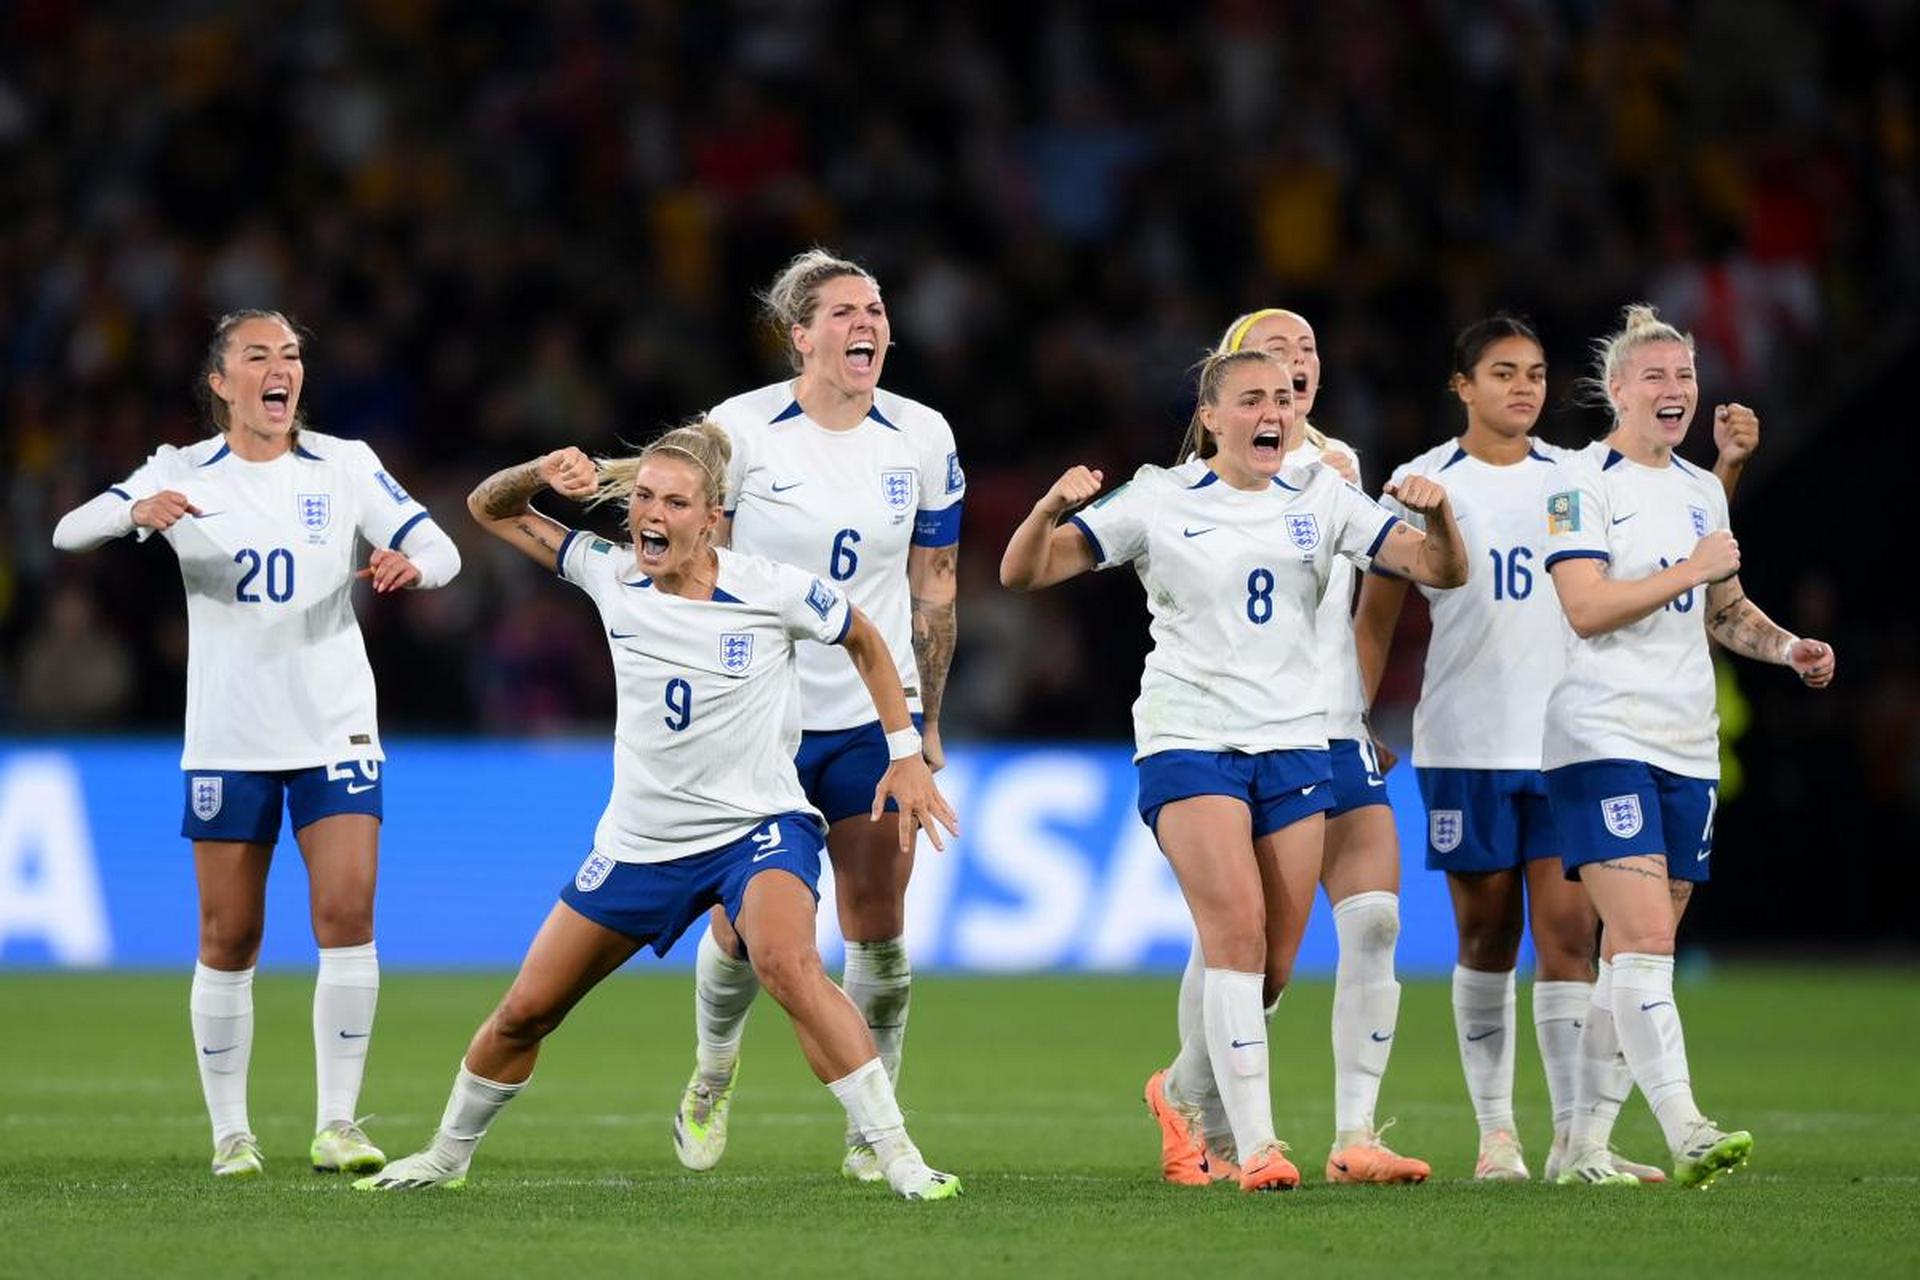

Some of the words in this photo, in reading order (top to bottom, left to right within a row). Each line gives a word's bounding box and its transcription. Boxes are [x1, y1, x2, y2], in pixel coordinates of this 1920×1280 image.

[234, 548, 294, 603] 20
[830, 528, 861, 581] 6
[1489, 547, 1532, 601] 16
[1247, 568, 1274, 624] 8
[664, 678, 692, 732] 9
